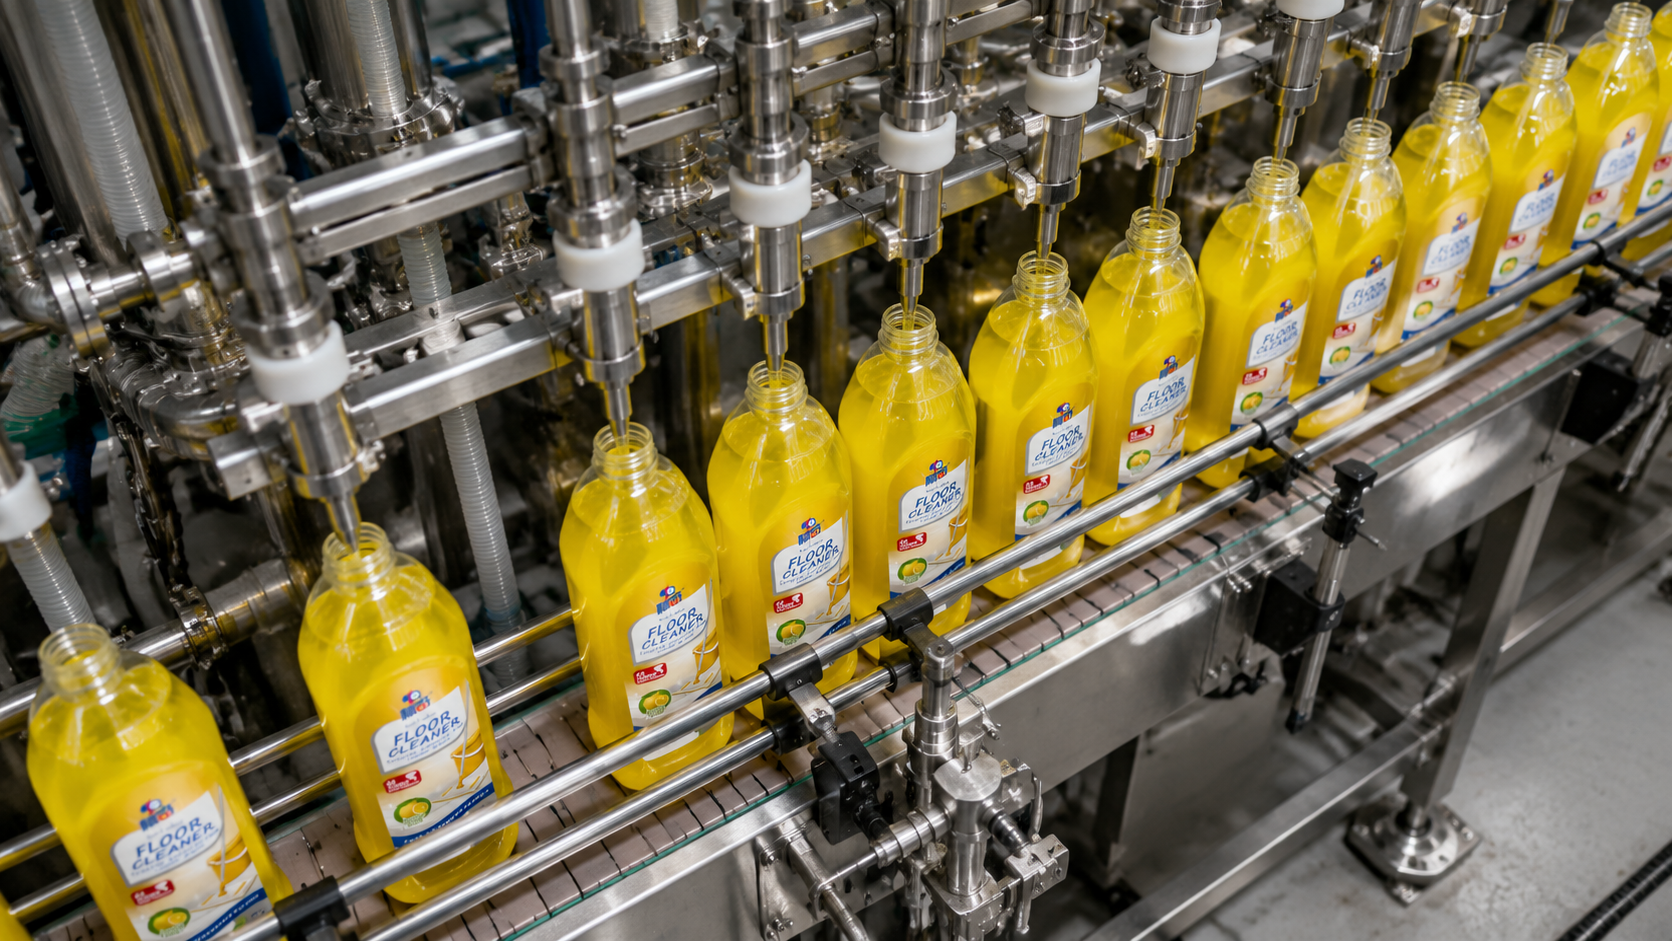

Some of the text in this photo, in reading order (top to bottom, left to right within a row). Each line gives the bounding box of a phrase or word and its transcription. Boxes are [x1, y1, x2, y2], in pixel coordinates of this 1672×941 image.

[1041, 424, 1081, 451] FLOOR
[915, 481, 957, 509] FLOOR
[788, 538, 834, 570] FLOOR
[648, 606, 698, 639] FLOOR
[388, 717, 461, 759] CLEANER
[394, 710, 452, 747] FLOOR
[132, 822, 215, 871] CLEANER
[136, 817, 202, 858] FLOOR
